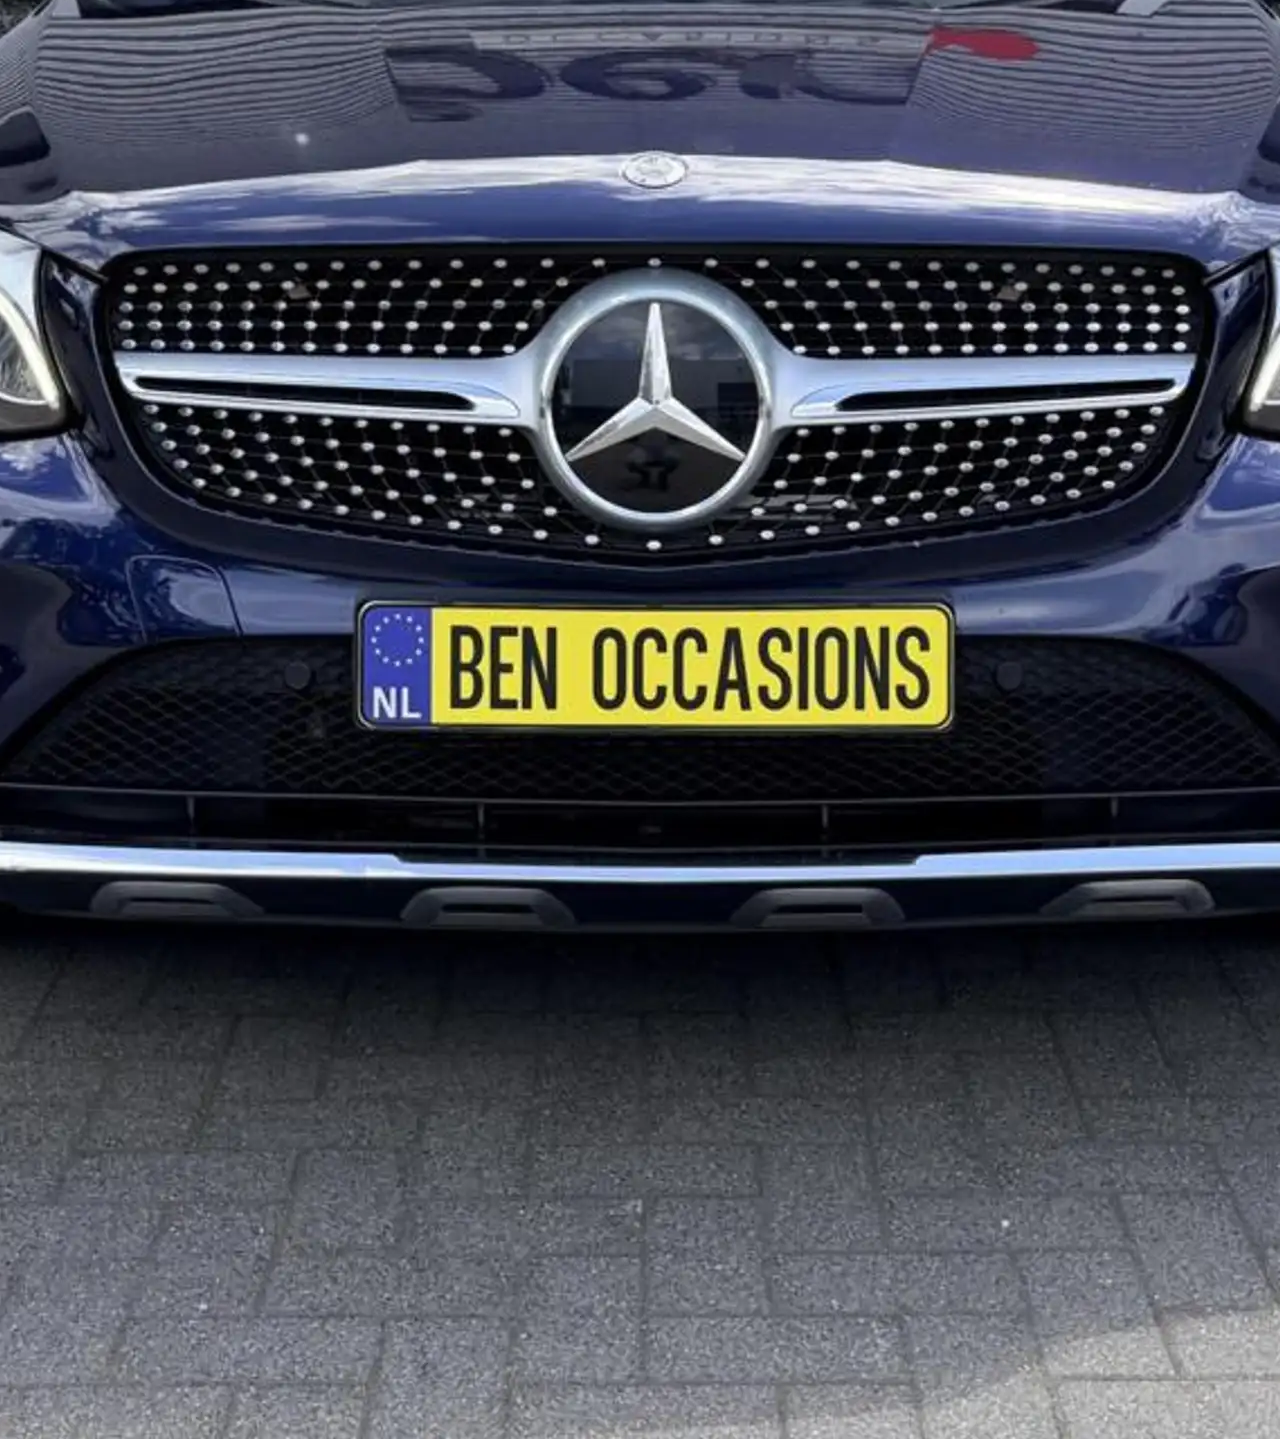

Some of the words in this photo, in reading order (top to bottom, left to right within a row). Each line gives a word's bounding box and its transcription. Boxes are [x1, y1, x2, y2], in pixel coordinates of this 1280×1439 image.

[449, 625, 558, 710] BEN
[593, 626, 931, 711] OCCASIONS
[372, 687, 422, 720] NL
